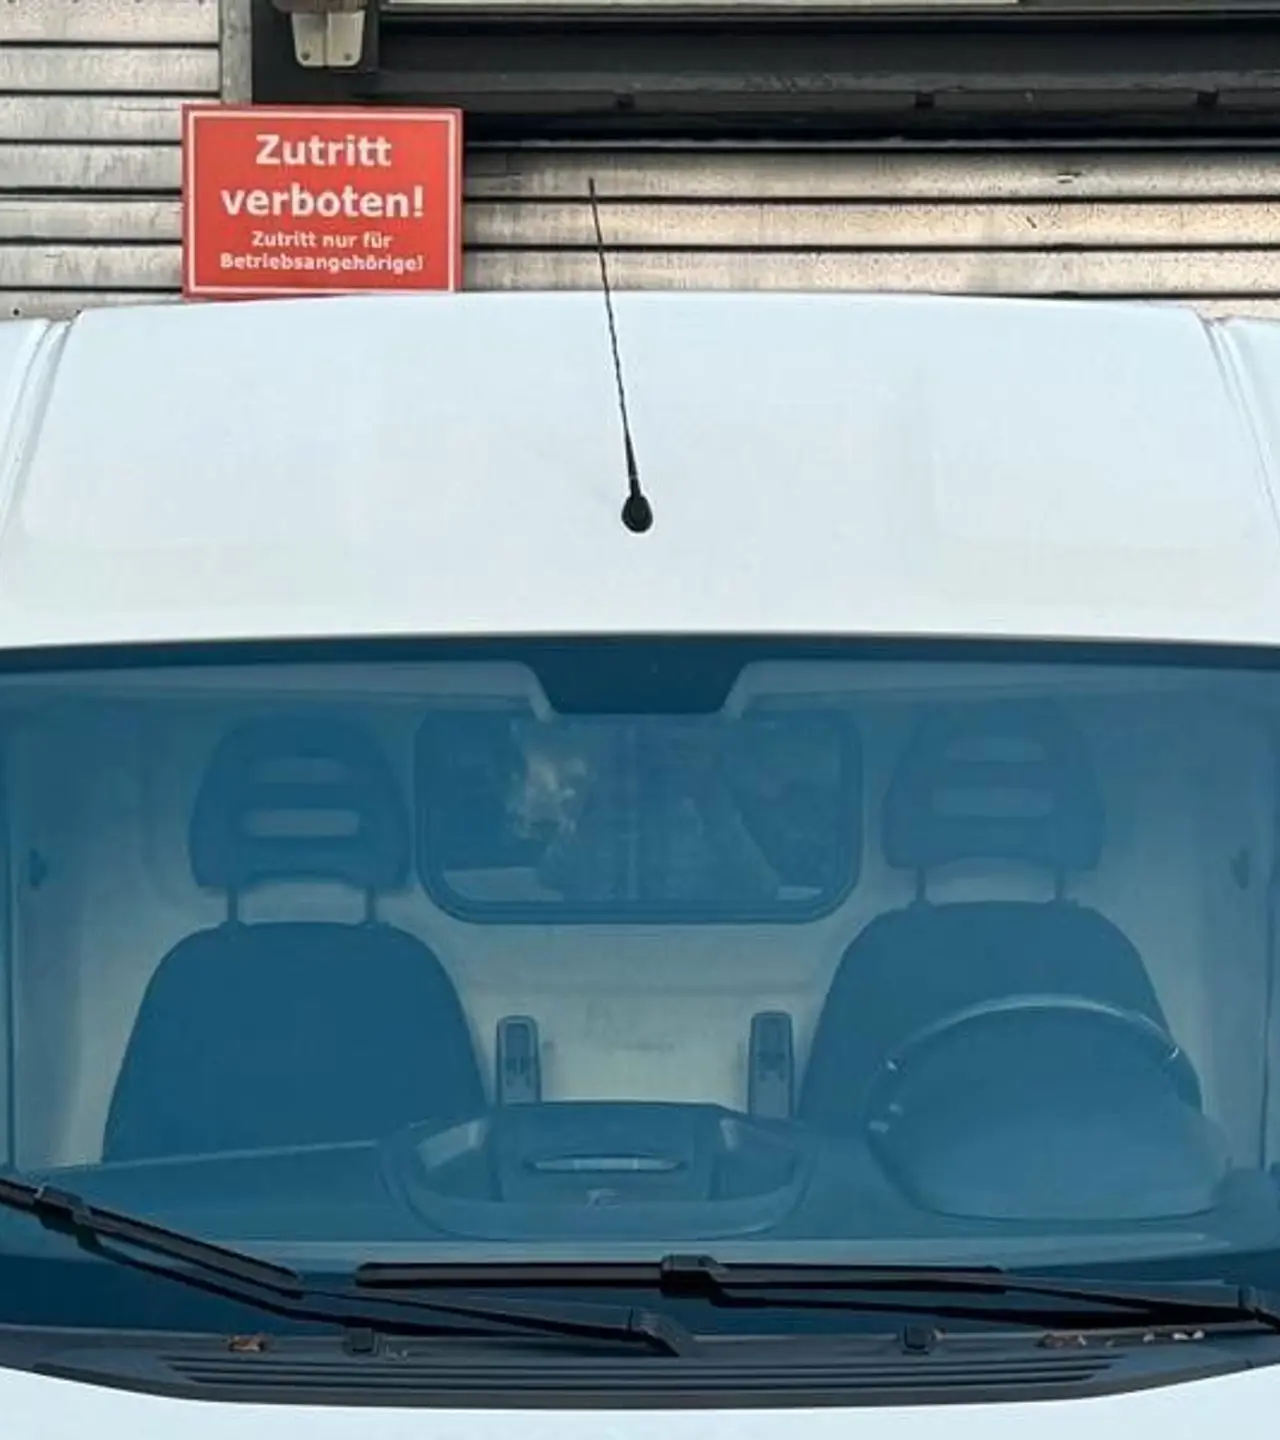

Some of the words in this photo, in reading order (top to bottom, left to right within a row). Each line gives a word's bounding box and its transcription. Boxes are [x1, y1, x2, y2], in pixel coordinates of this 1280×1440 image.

[254, 133, 392, 167] Zutritt
[220, 182, 424, 218] verboten!
[251, 230, 316, 248] Zutritt
[321, 234, 356, 249] nur
[363, 230, 394, 249] für
[219, 252, 424, 275] Betriebsangehörige!
